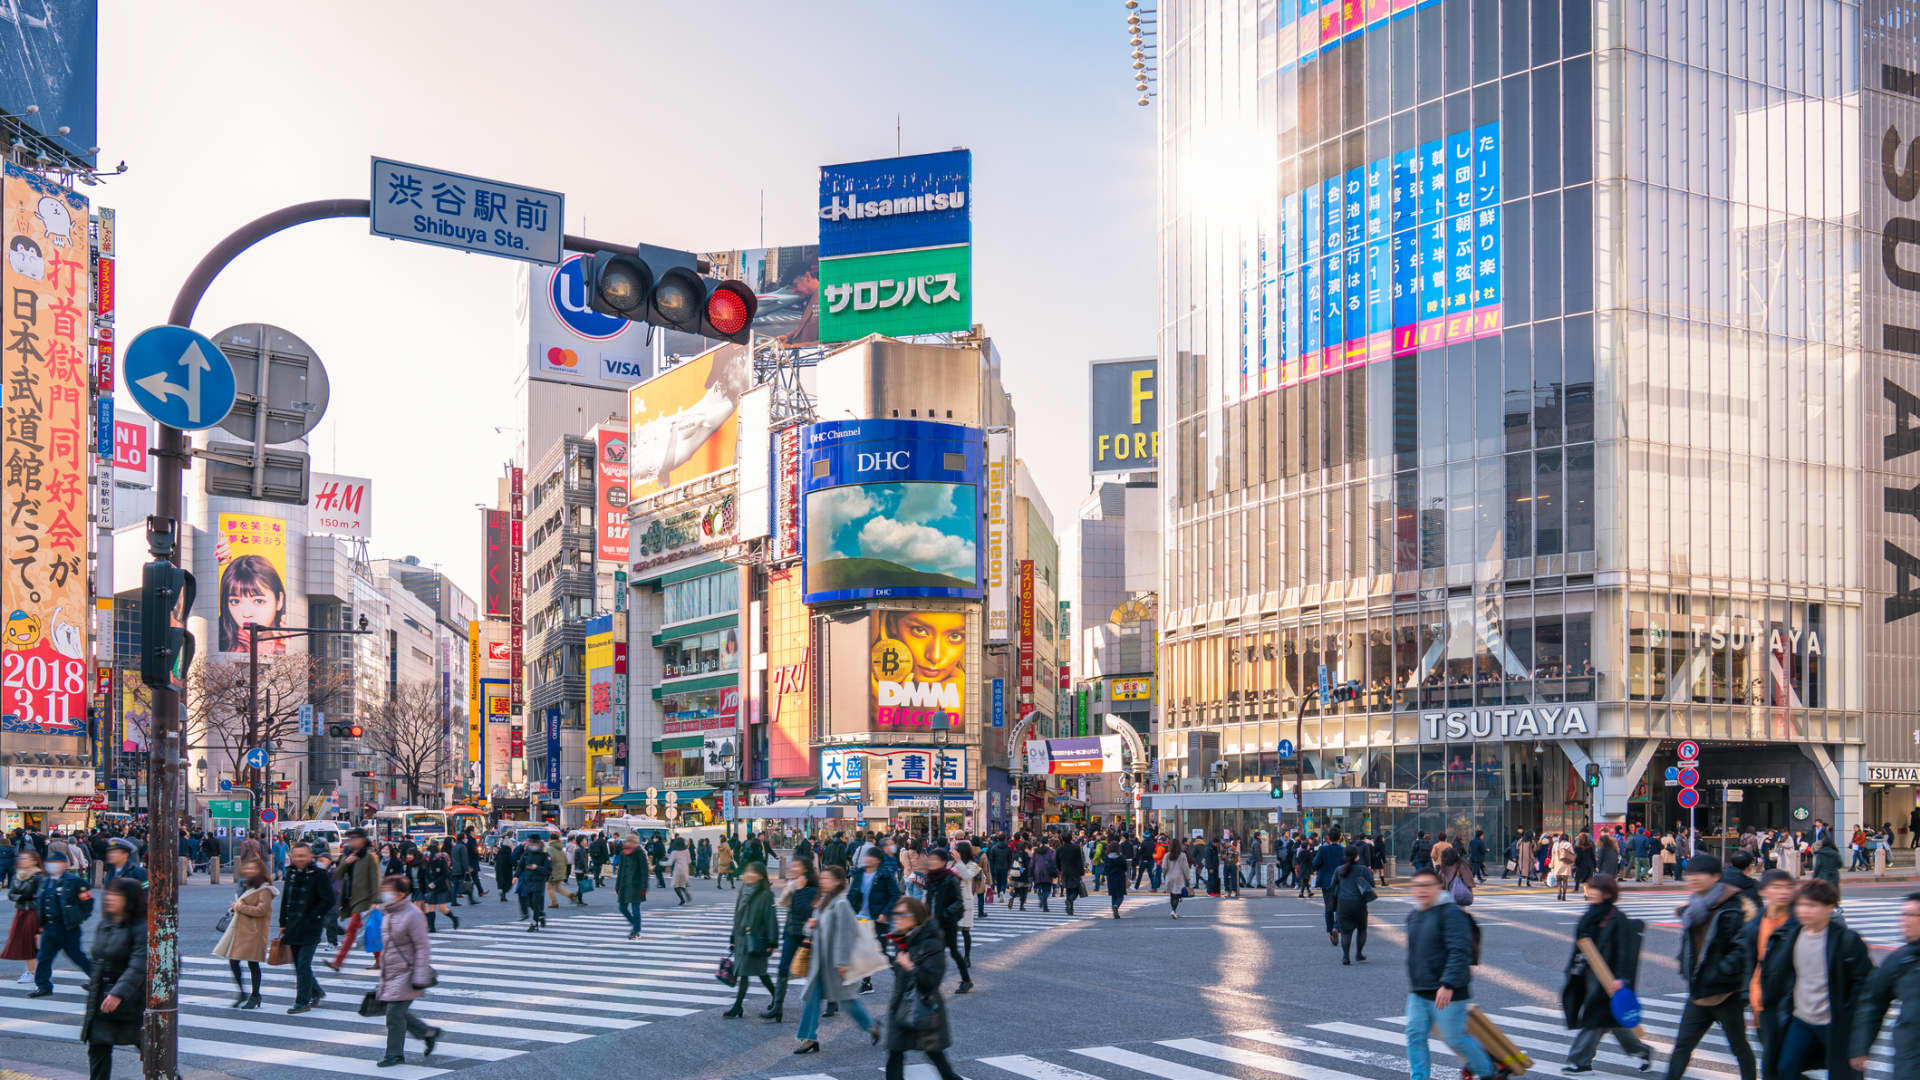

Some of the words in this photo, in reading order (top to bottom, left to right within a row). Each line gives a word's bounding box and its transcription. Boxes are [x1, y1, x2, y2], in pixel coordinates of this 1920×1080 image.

[388, 172, 549, 232] 渋谷駅前
[818, 191, 964, 221] Hisamitsu
[413, 215, 487, 244] Shibuya
[494, 229, 529, 251] Sta.
[824, 273, 961, 313] サロンパス
[605, 359, 641, 377] VISA
[1131, 370, 1153, 424] F
[43, 249, 84, 588] 打首獄門同好会が
[810, 430, 827, 443] DHC
[828, 427, 861, 440] Channel
[6, 287, 45, 604] 日本武道館だって。
[857, 450, 910, 472] DHC
[100, 471, 110, 524] 渋谷駅前ビル
[315, 481, 365, 515] H&M
[990, 456, 1005, 525] Taisei
[991, 532, 1002, 588] neon
[1692, 622, 1822, 655] TSUTAYA
[3, 653, 84, 694] 2018
[14, 688, 71, 725] 3.11
[878, 681, 960, 708] DMM
[878, 707, 960, 727] Bitcon
[1424, 707, 1588, 739] TSUTAYA
[827, 754, 958, 781] 大盛書店
[1869, 768, 1918, 779] TSUTAYA
